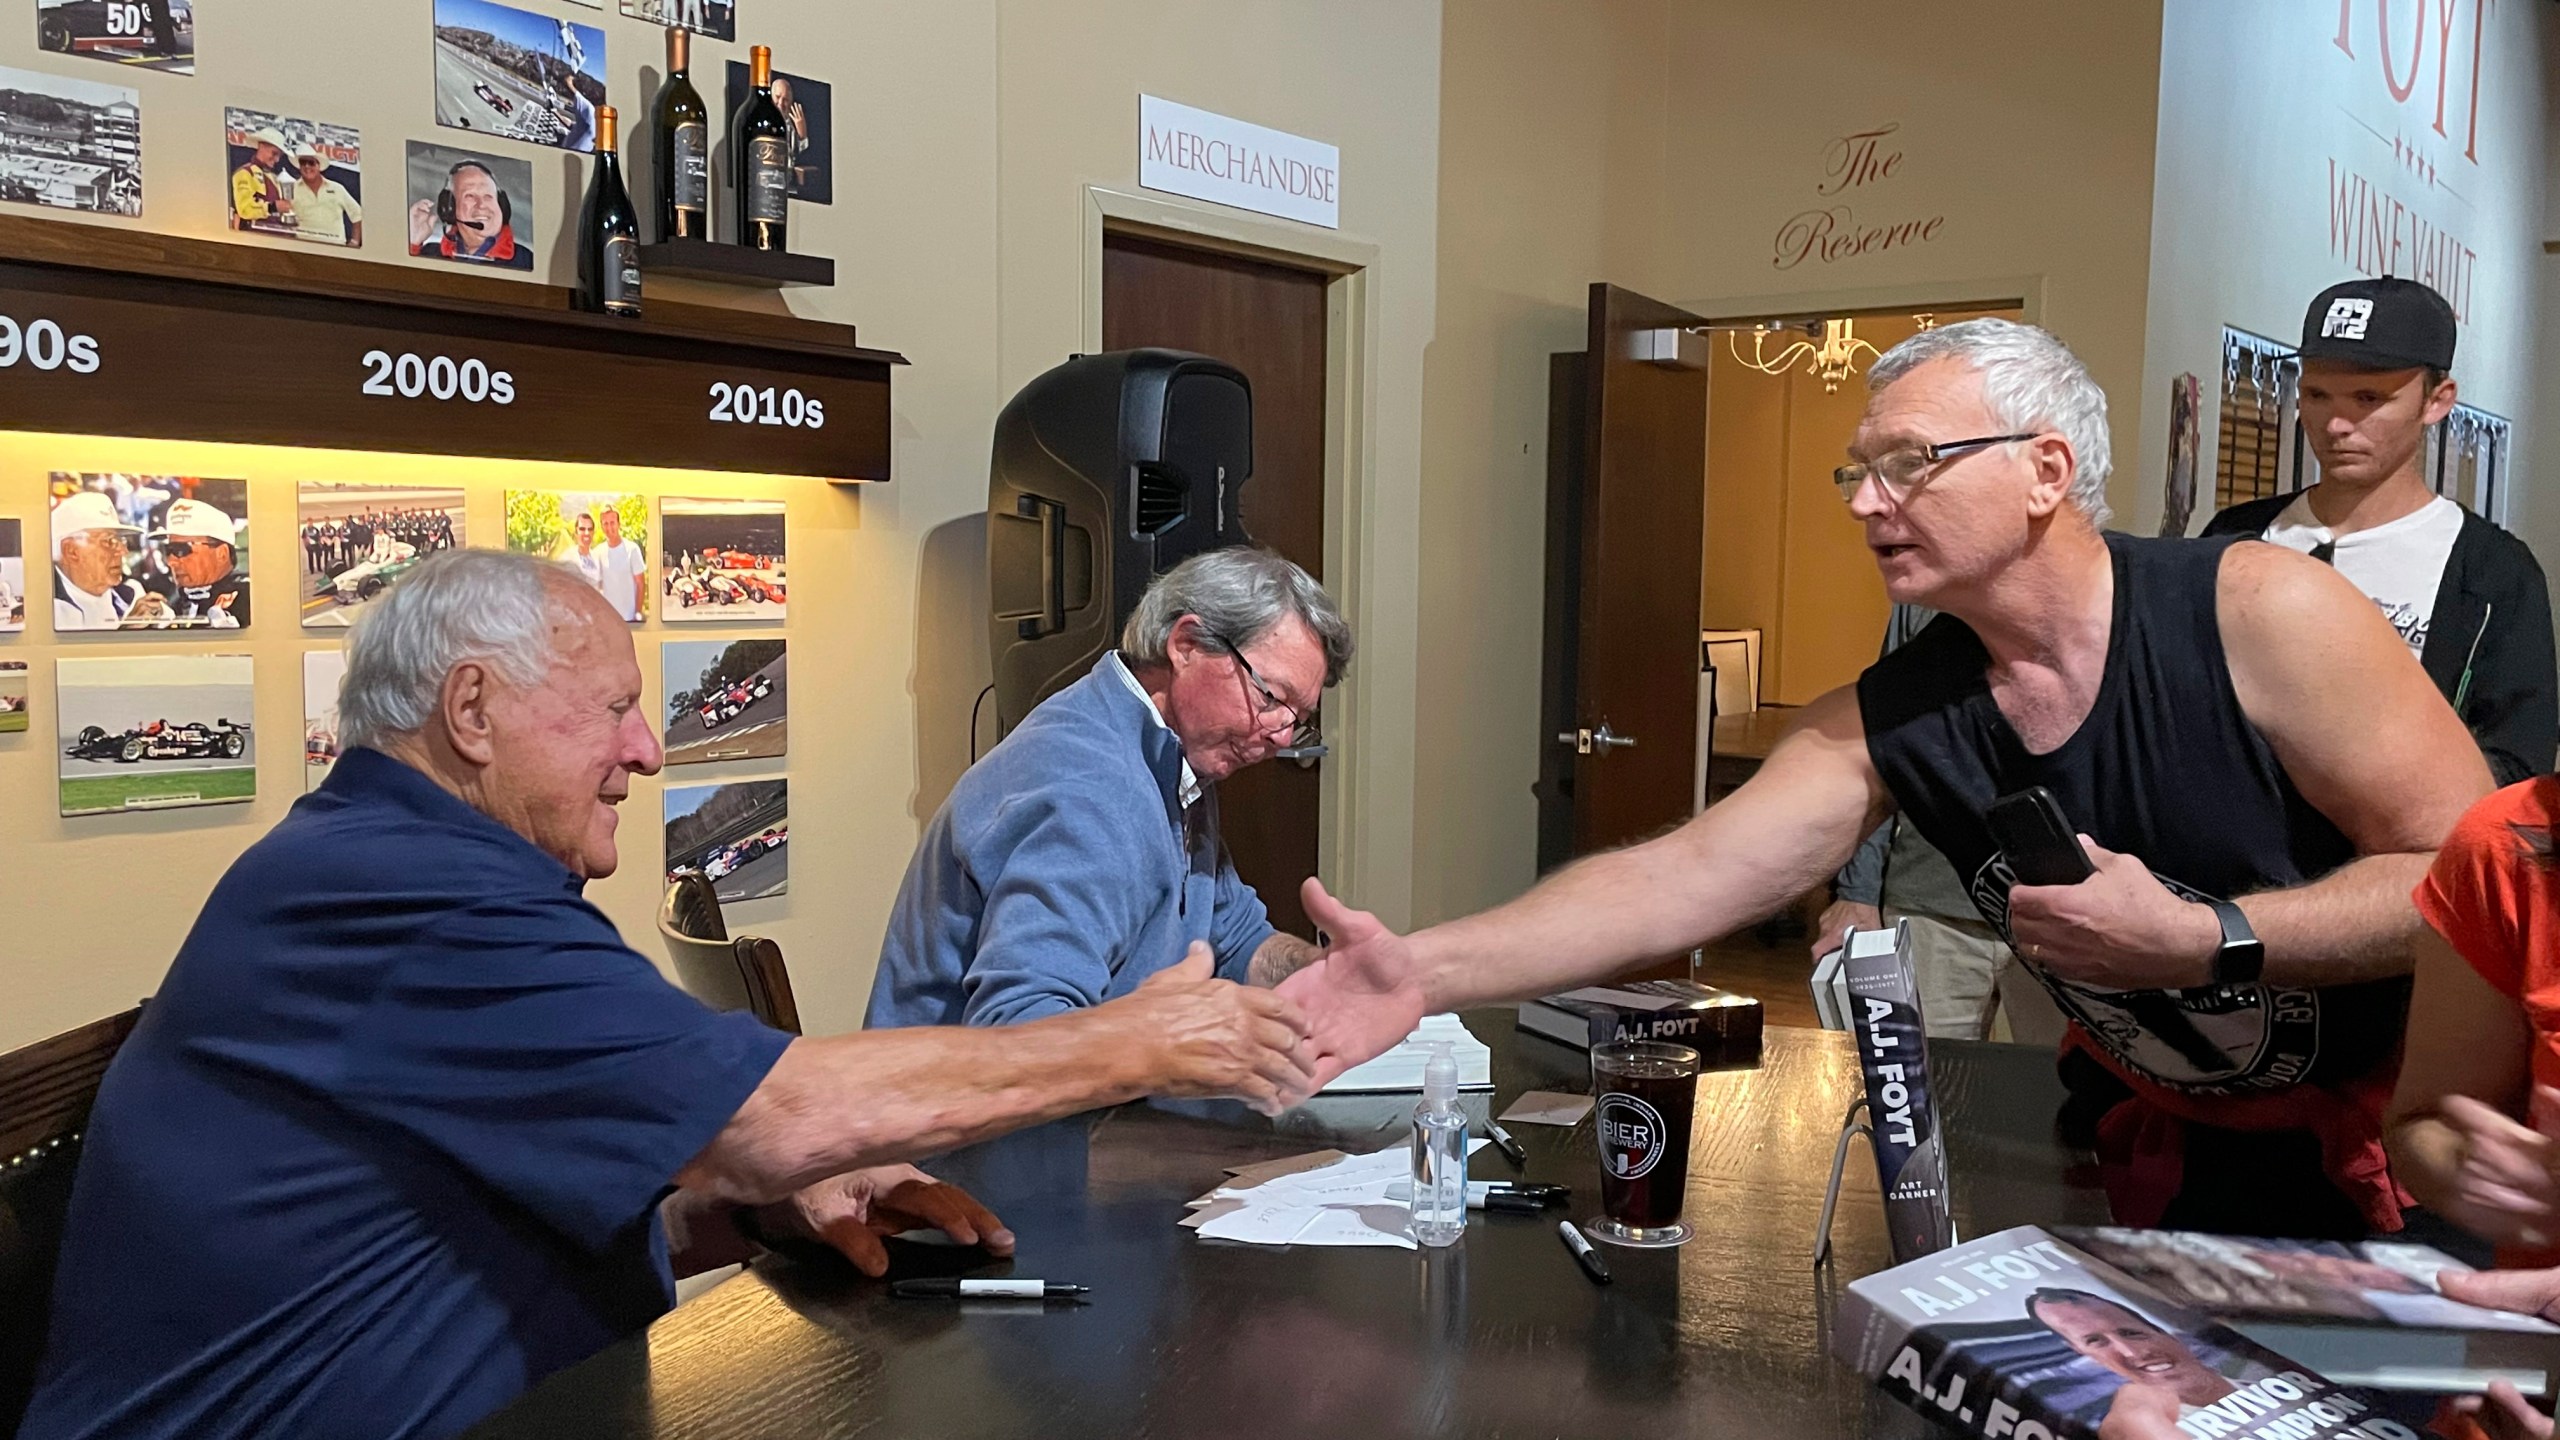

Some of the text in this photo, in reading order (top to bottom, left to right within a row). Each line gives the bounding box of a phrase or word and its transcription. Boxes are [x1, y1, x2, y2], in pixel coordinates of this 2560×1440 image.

[107, 3, 140, 35] 50
[1148, 123, 1335, 204] MERCHANDISE
[1818, 122, 1902, 196] The
[1773, 205, 1944, 271] Reserve
[361, 350, 515, 404] 2000s
[708, 382, 825, 428] 2010s
[1849, 972, 1899, 983] VOLUME ONE
[1651, 1017, 1699, 1038] FOYT
[1864, 998, 1917, 1148] A.J. FOYT
[1602, 1118, 1649, 1142] BIER
[1889, 1189, 1937, 1201] GARNER
[1899, 1180, 1922, 1190] ART
[1899, 1240, 2082, 1318] A.J. FOYT
[1886, 1345, 1974, 1424] A.J.
[2175, 1370, 2325, 1440] URVIVOR
